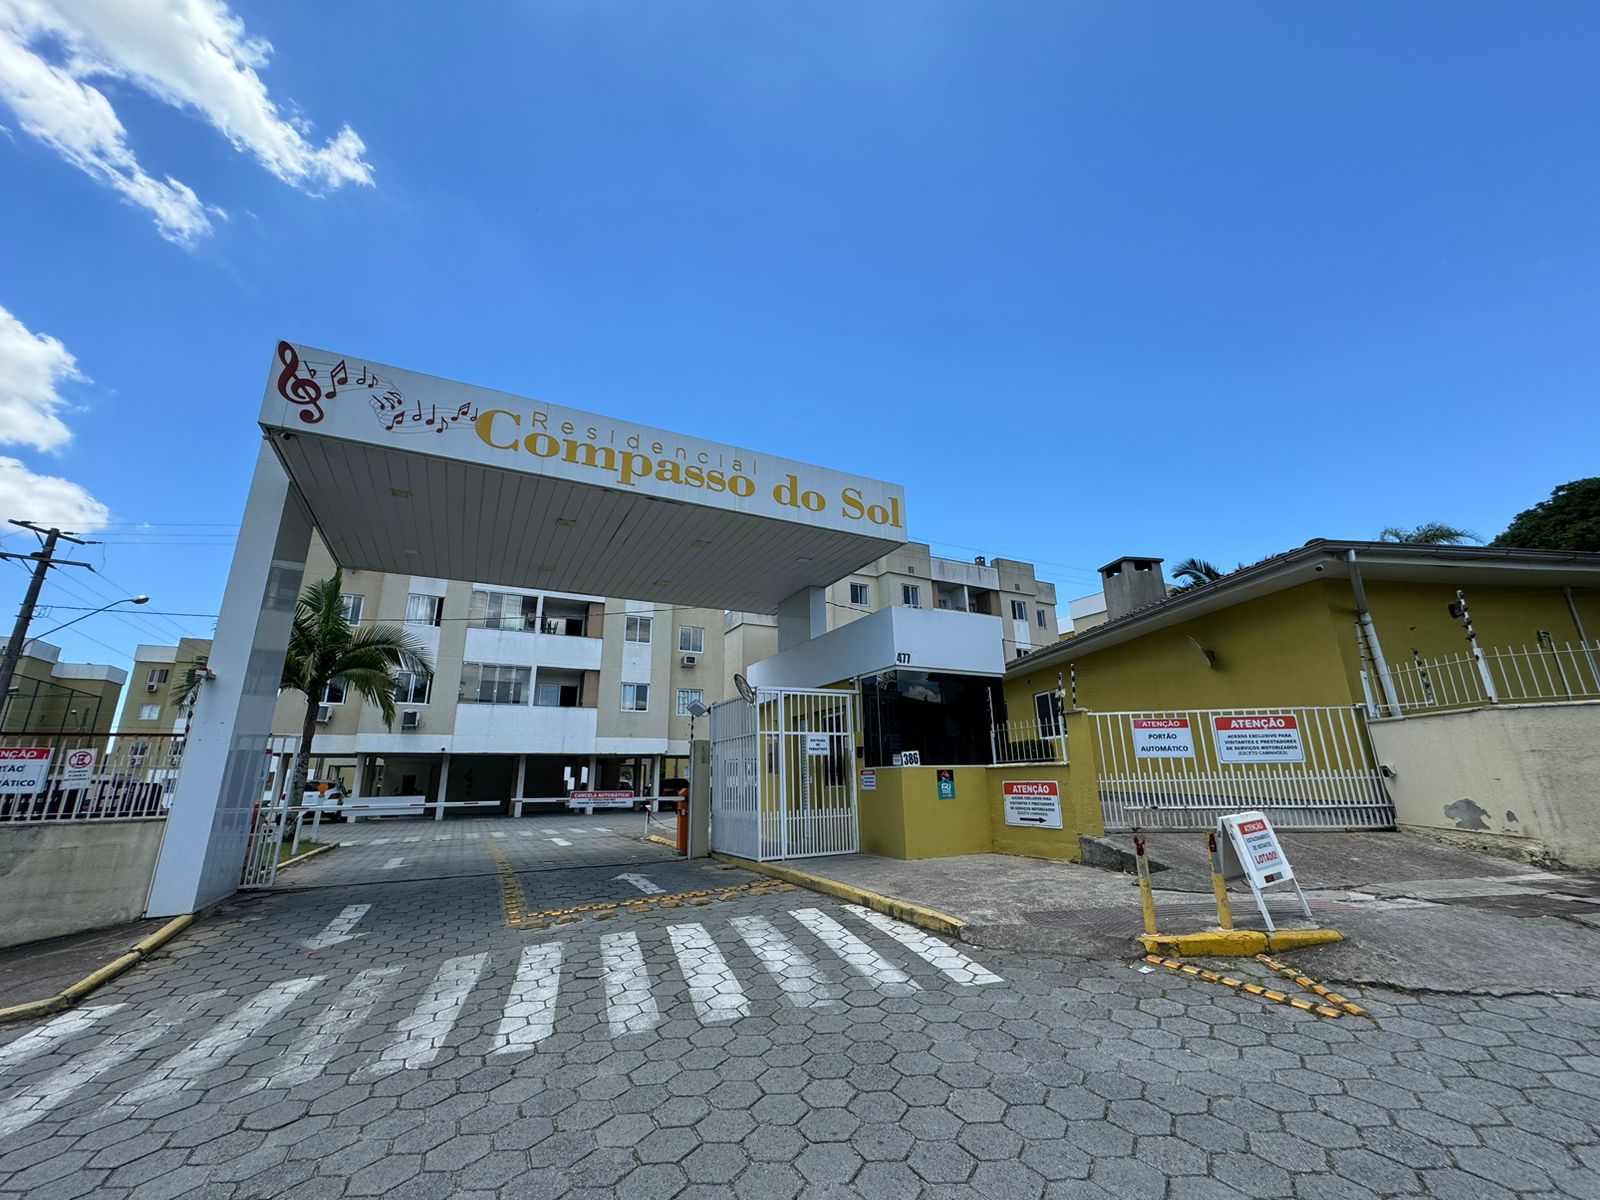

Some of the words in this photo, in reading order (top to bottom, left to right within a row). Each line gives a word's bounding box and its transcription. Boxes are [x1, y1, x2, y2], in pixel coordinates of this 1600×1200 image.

[532, 411, 757, 475] Residencial
[475, 409, 756, 497] Compasso
[773, 474, 826, 512] do
[841, 487, 902, 528] Sol
[897, 652, 910, 664] 477
[1141, 720, 1180, 728] ATENÇÃO
[1230, 717, 1286, 730] ATENÇÃO
[903, 752, 919, 765] 386
[0, 779, 35, 787] ÁTICO
[1012, 784, 1050, 795] ATENÇÃO
